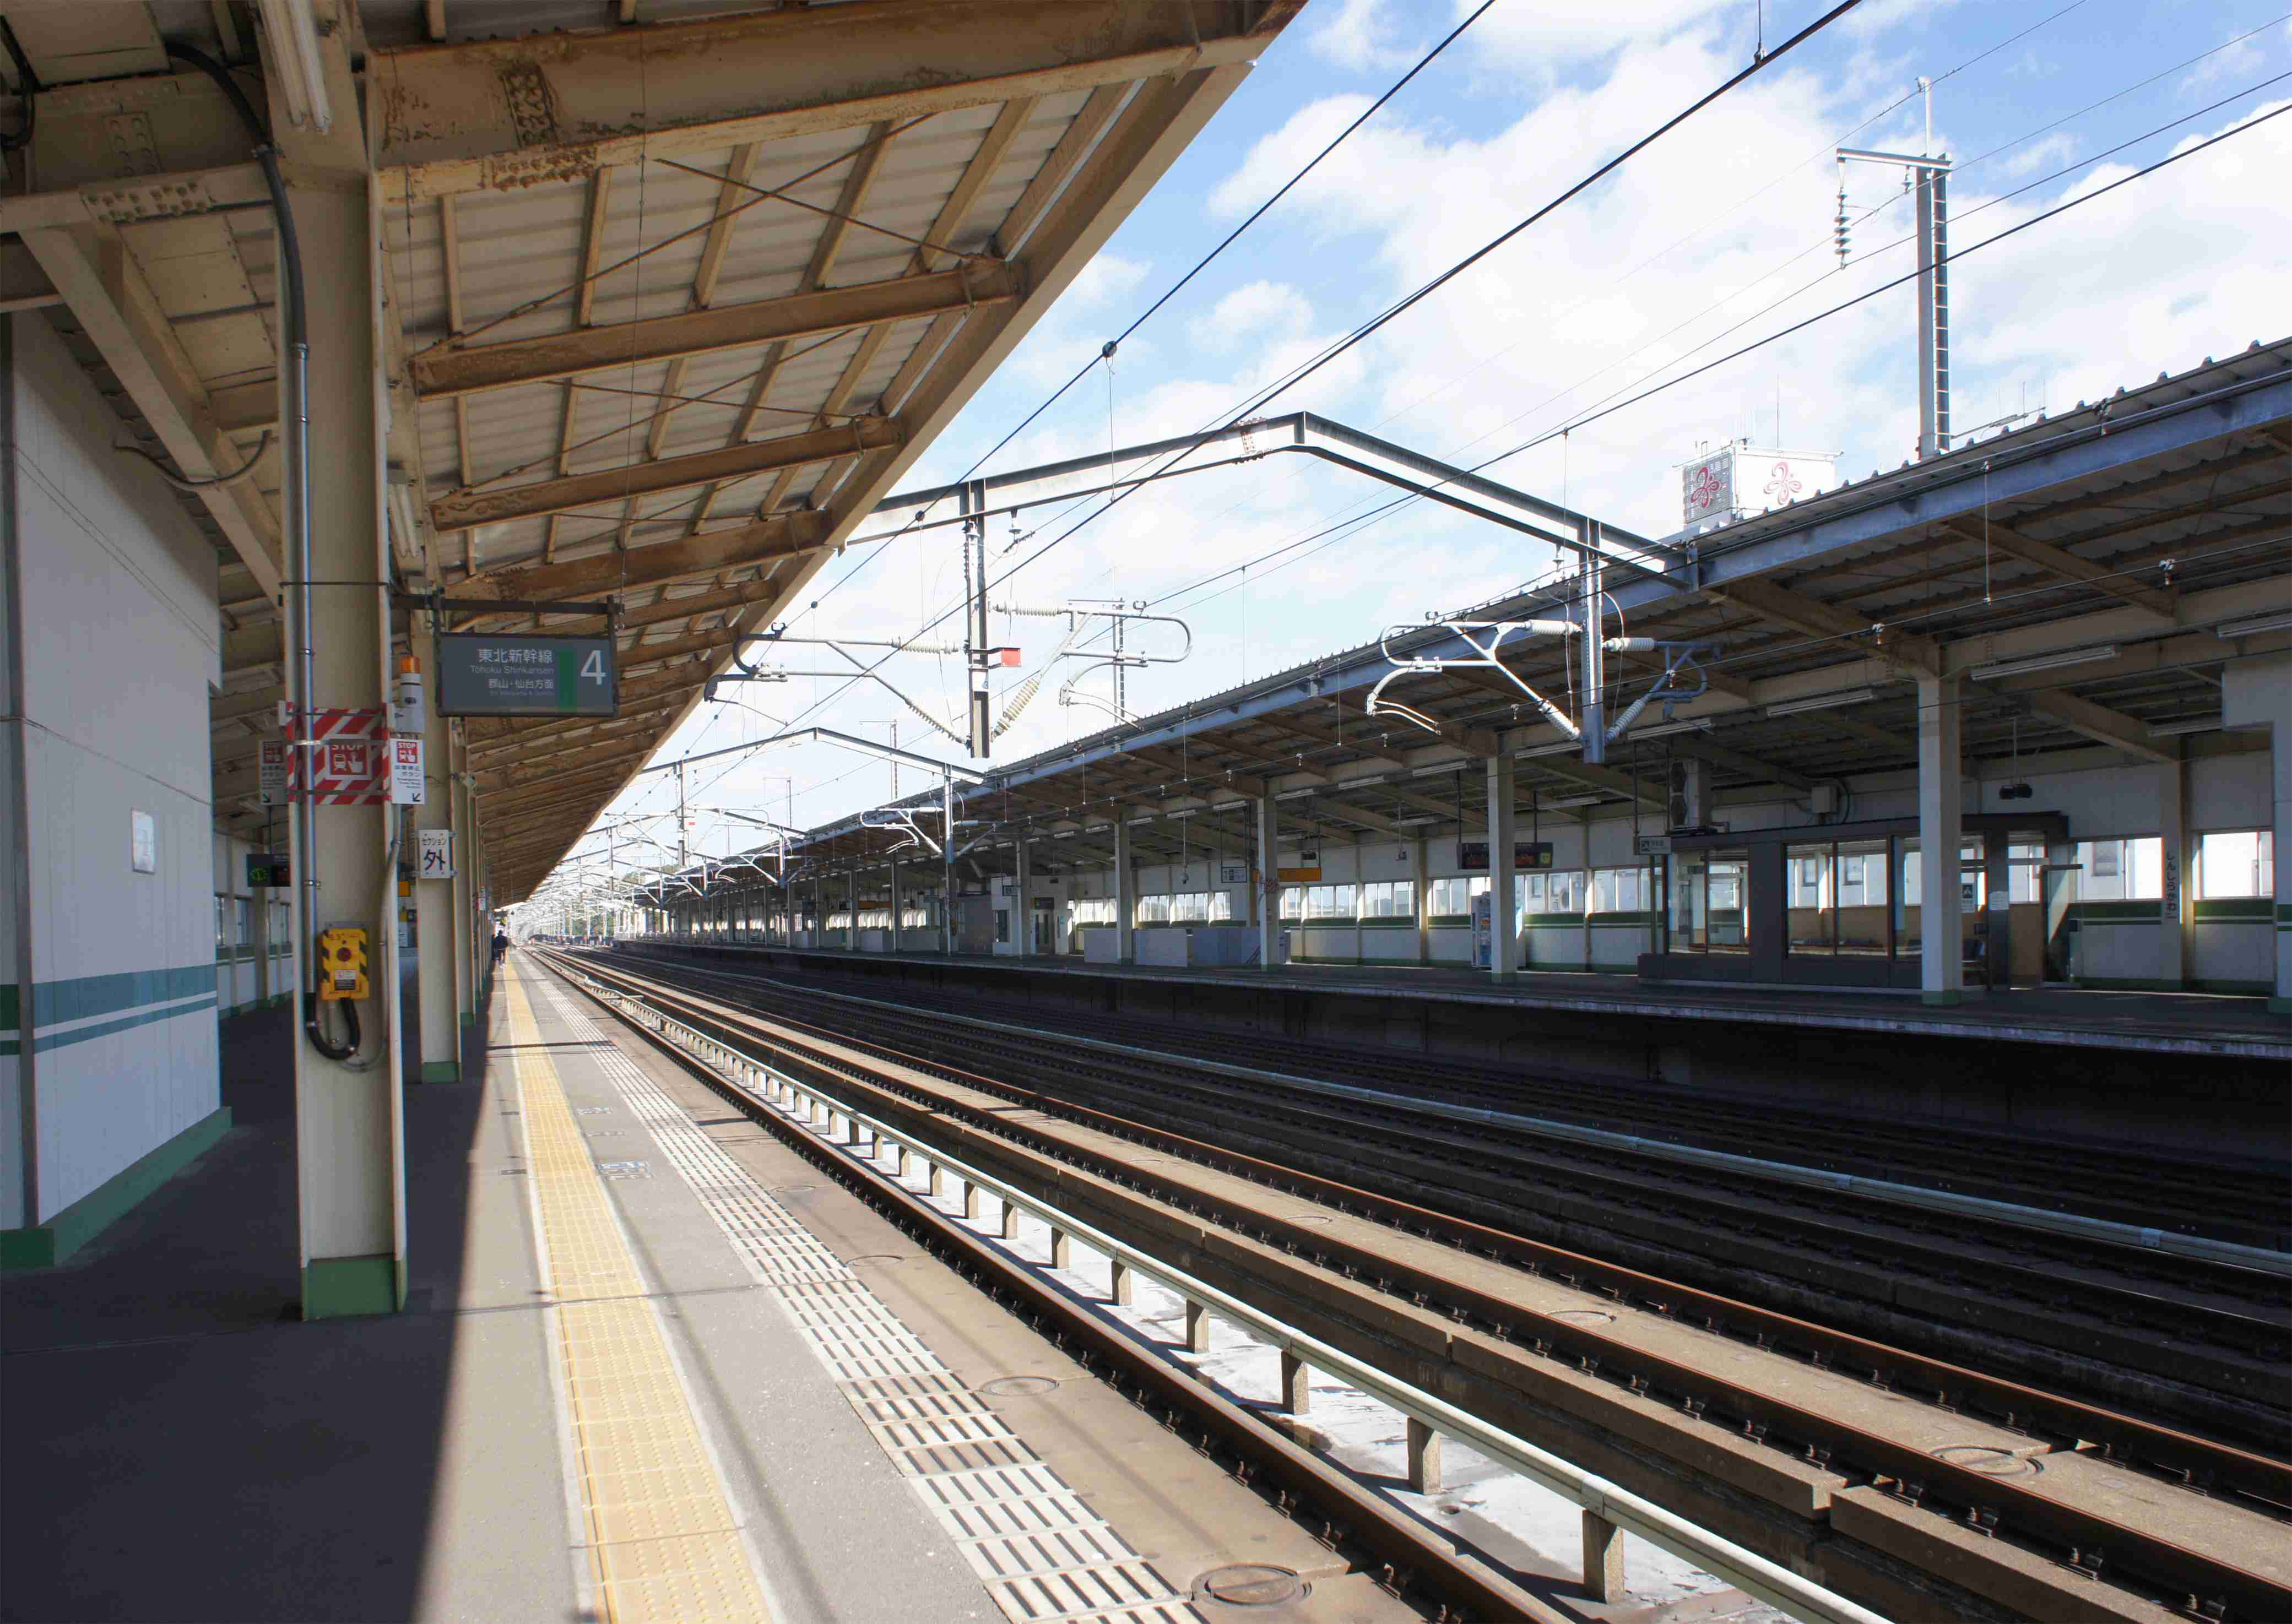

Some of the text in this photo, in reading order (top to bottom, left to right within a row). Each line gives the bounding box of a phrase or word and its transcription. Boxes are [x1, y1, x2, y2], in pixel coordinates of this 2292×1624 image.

[478, 648, 553, 664] 東北新幹線
[580, 650, 606, 685] 4
[423, 849, 446, 871] 外
